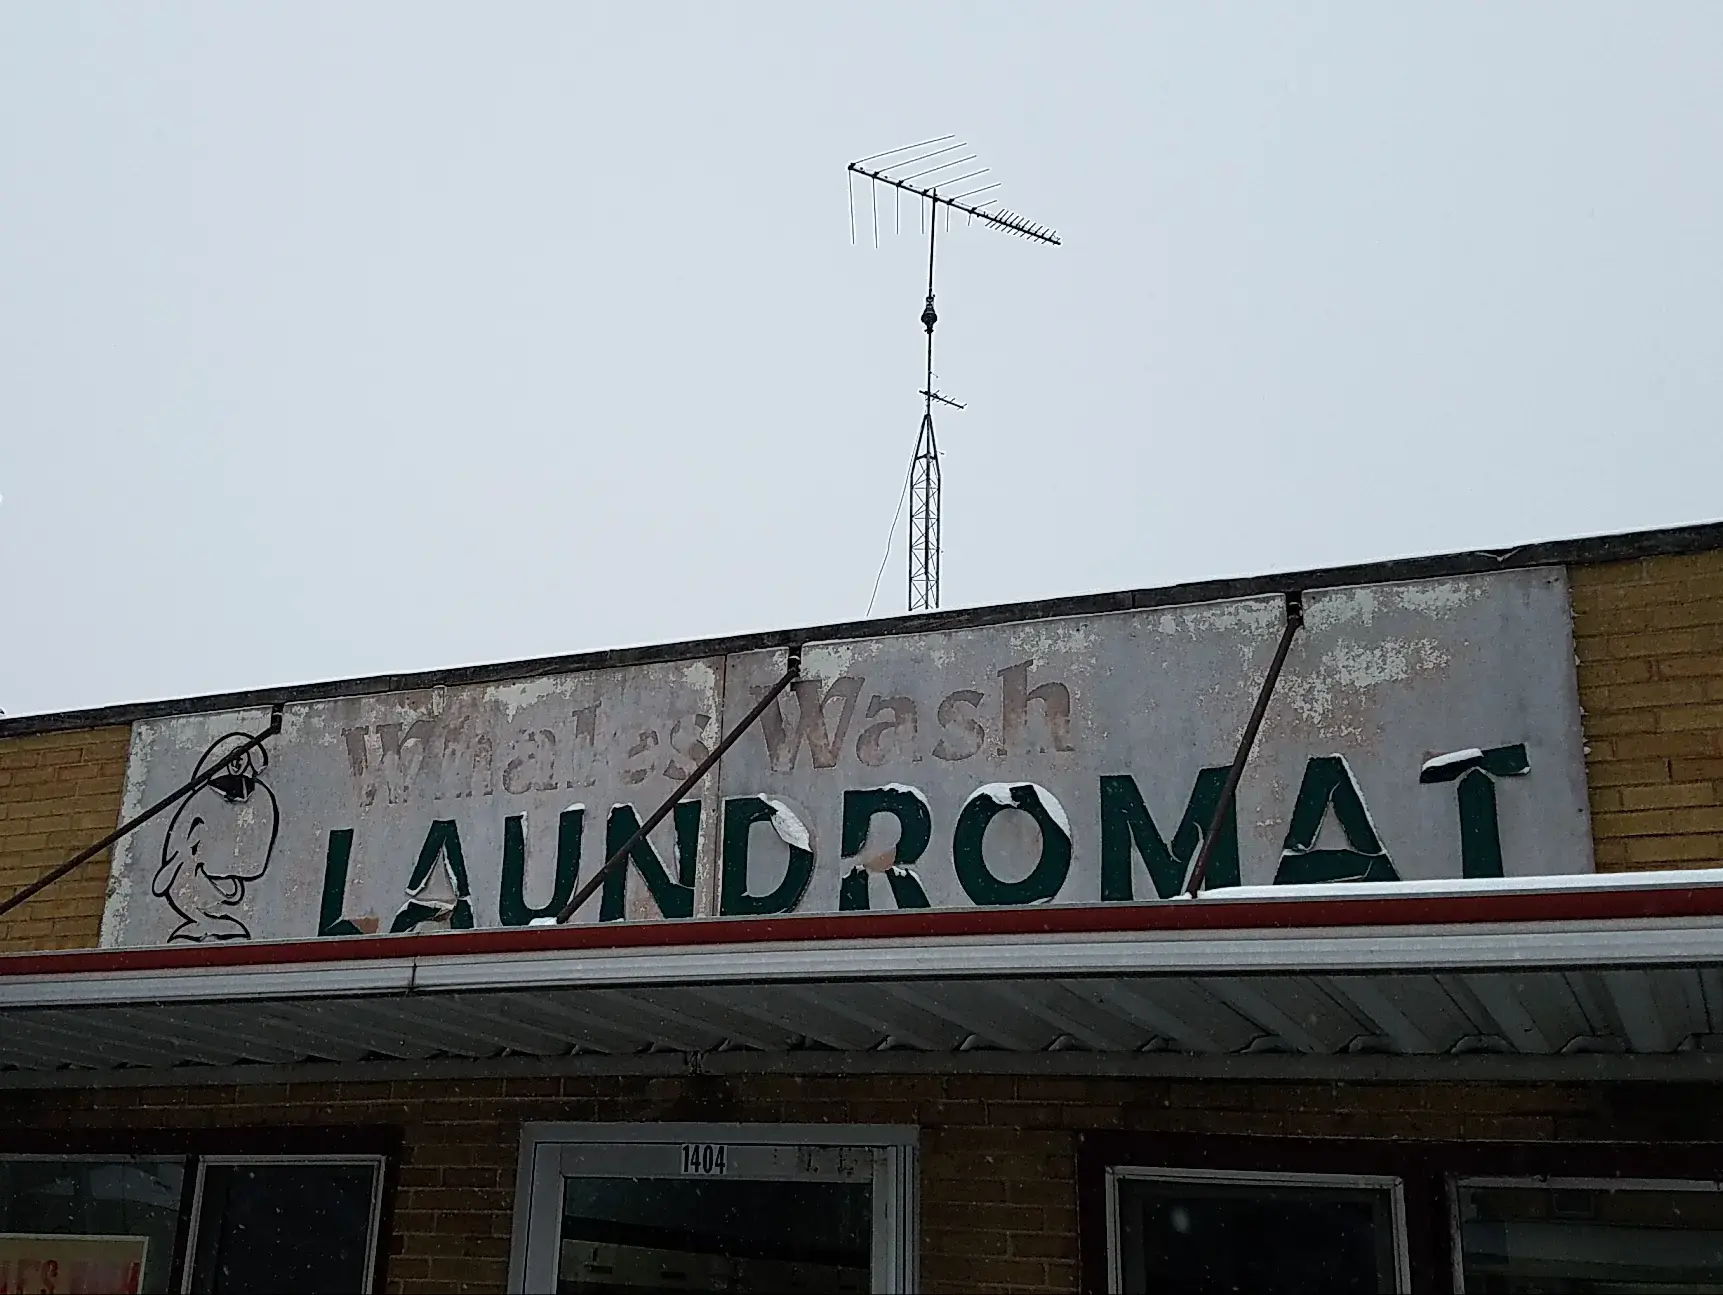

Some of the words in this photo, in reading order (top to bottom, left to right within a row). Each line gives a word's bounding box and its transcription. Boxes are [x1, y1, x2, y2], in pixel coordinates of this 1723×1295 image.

[342, 700, 712, 807] Whales
[749, 659, 1076, 772] Wash
[318, 743, 1531, 938] LAUNDROMAT
[682, 1145, 726, 1174] 1404
